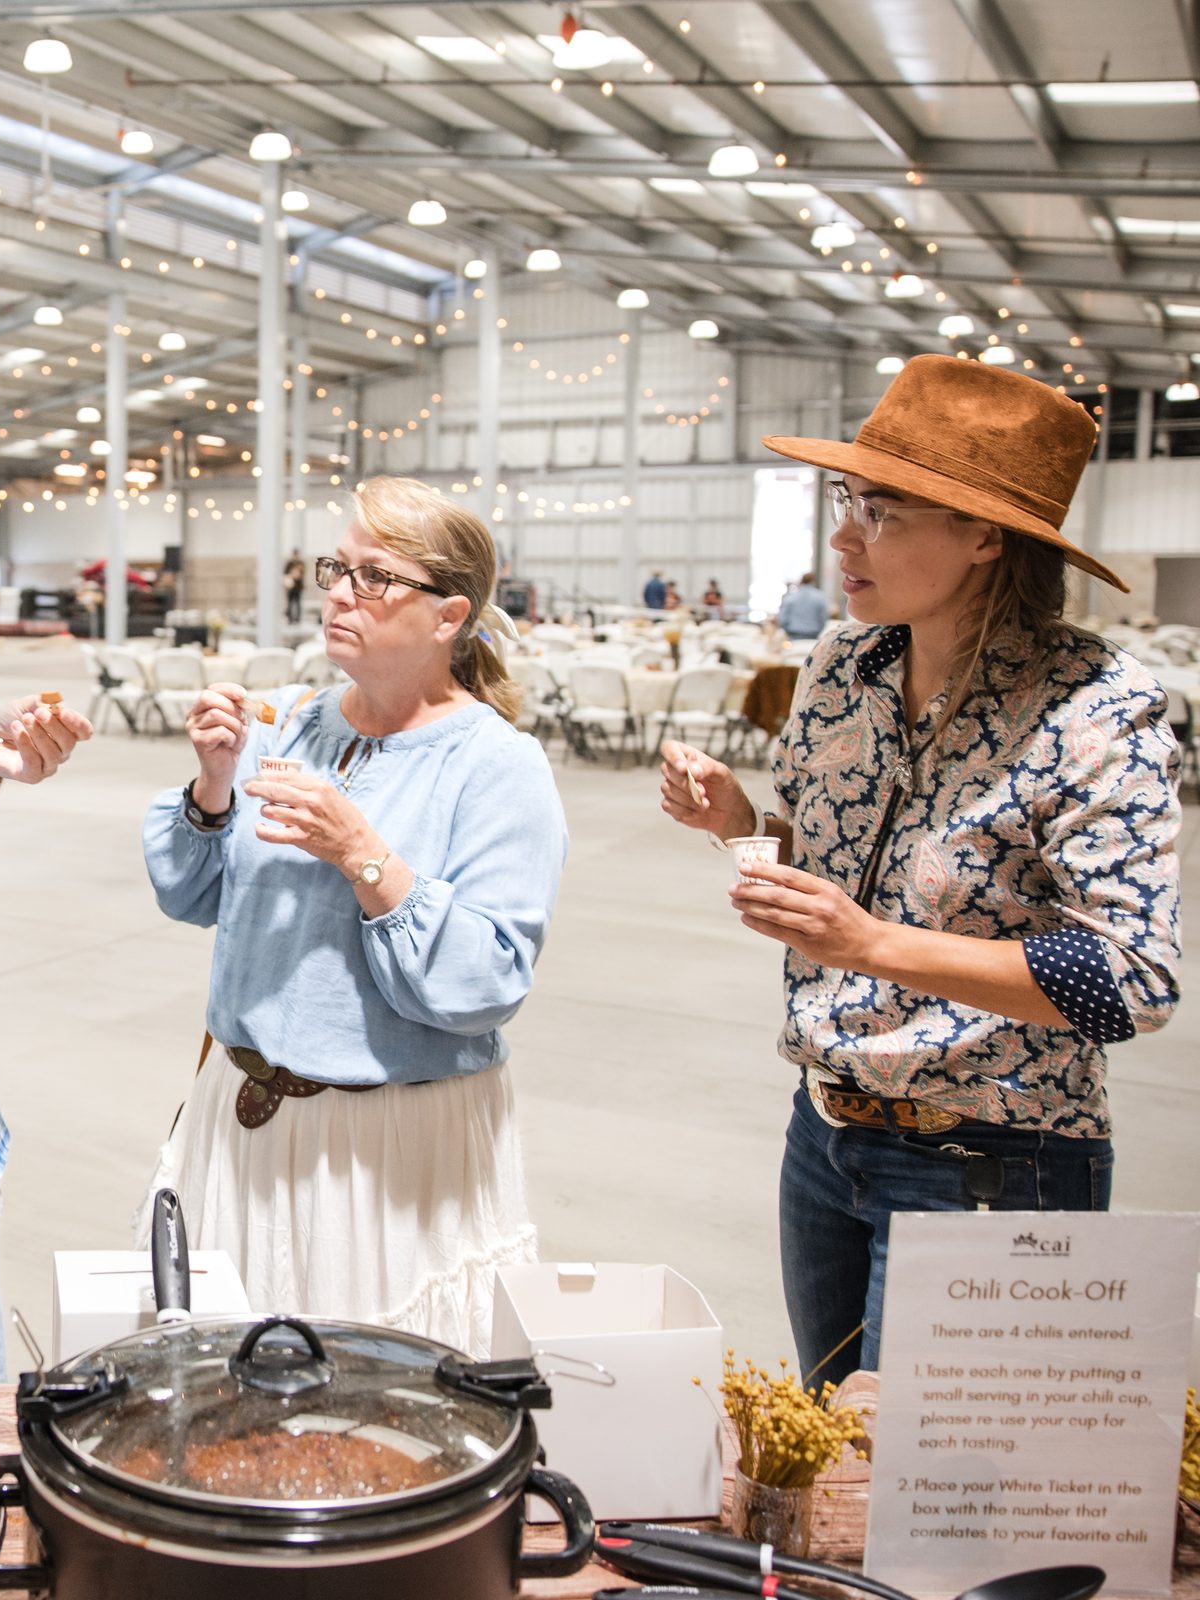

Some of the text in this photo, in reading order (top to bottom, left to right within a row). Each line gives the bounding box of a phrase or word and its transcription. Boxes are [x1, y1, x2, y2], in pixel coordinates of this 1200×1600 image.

[1040, 1235, 1071, 1252] cai
[947, 1278, 1127, 1302] Chili Cook-Off
[931, 1323, 1134, 1340] There are 4 chilis entered.
[914, 1363, 1142, 1384] 1. Taste each one by putting a
[922, 1387, 1152, 1408] small serving in your chili cup,
[919, 1412, 1126, 1431] please re-use your cup for
[918, 1435, 1019, 1454] each tasting.
[897, 1477, 1142, 1496] 2. Place your White Ticket in the
[911, 1501, 1108, 1518] box with the number that
[909, 1525, 1148, 1543] correlates to your favorite chili
